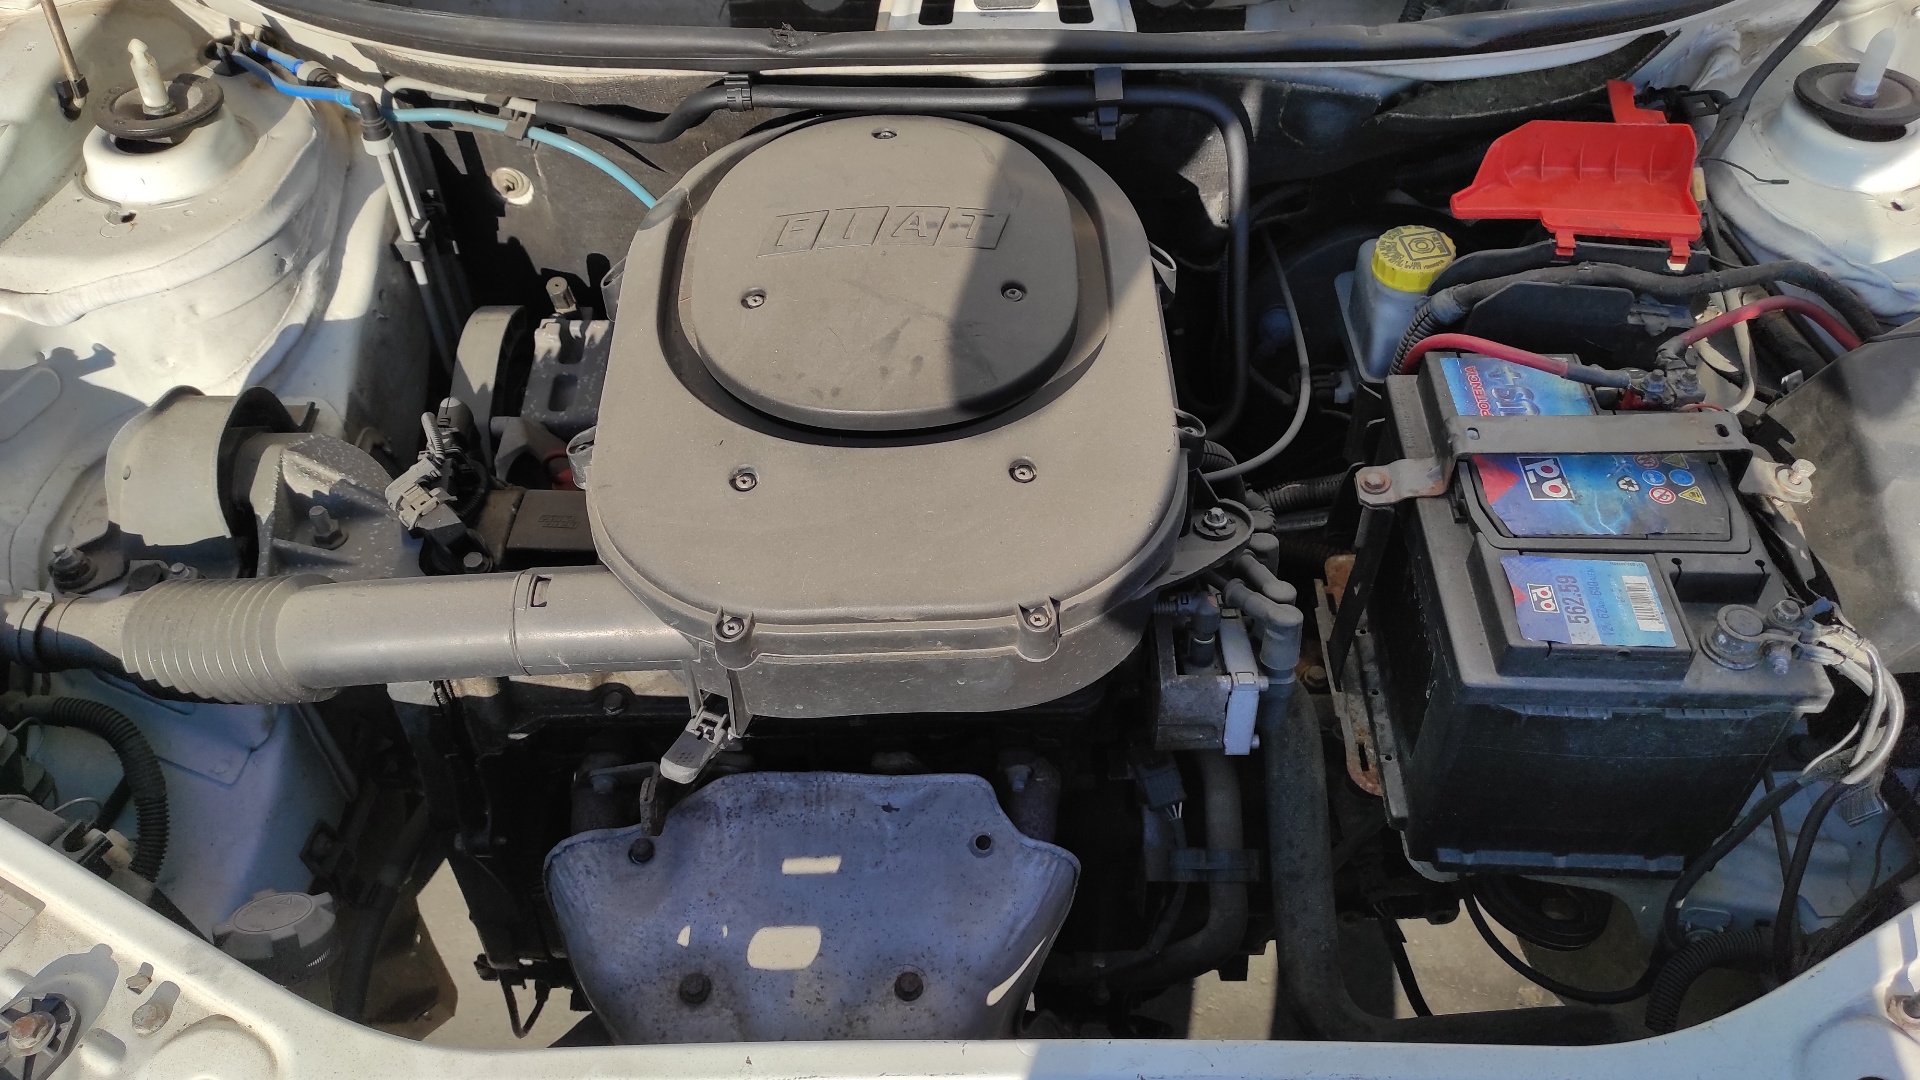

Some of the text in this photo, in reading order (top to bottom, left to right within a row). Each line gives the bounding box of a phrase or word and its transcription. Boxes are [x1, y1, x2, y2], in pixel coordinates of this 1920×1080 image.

[775, 210, 996, 247] FIAT
[1465, 366, 1494, 416] POTENCIA
[1554, 574, 1590, 625] 562.59
